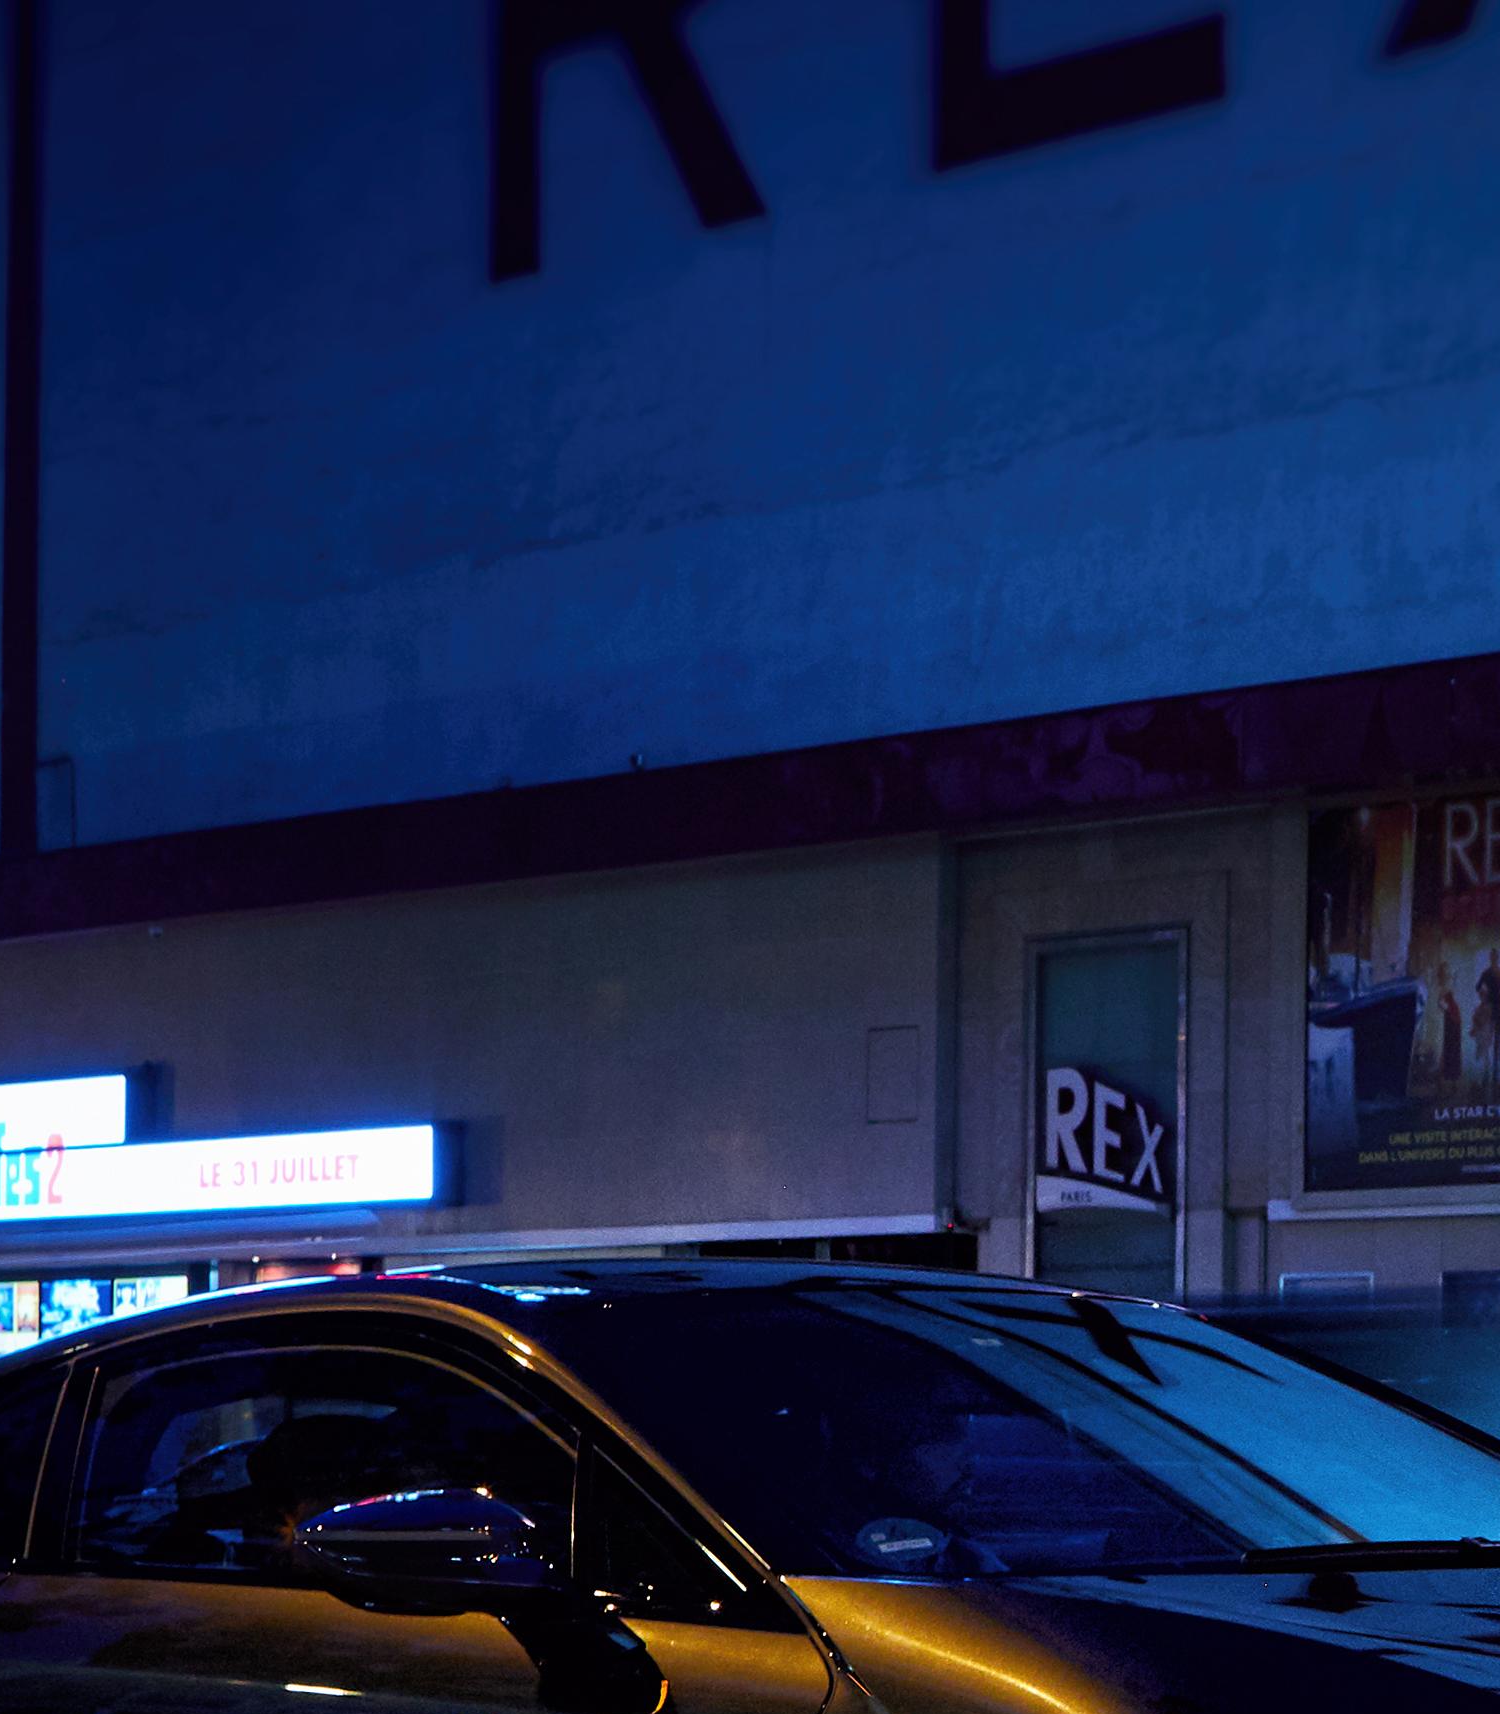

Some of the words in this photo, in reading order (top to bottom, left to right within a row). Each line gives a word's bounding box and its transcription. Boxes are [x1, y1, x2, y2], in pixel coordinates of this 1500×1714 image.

[1046, 1066, 1164, 1195] REX
[1434, 1108, 1450, 1121] LA
[1453, 1106, 1483, 1120] STAR
[200, 1163, 221, 1188] LE
[233, 1160, 258, 1187] 31
[269, 1154, 359, 1185] JUILLET
